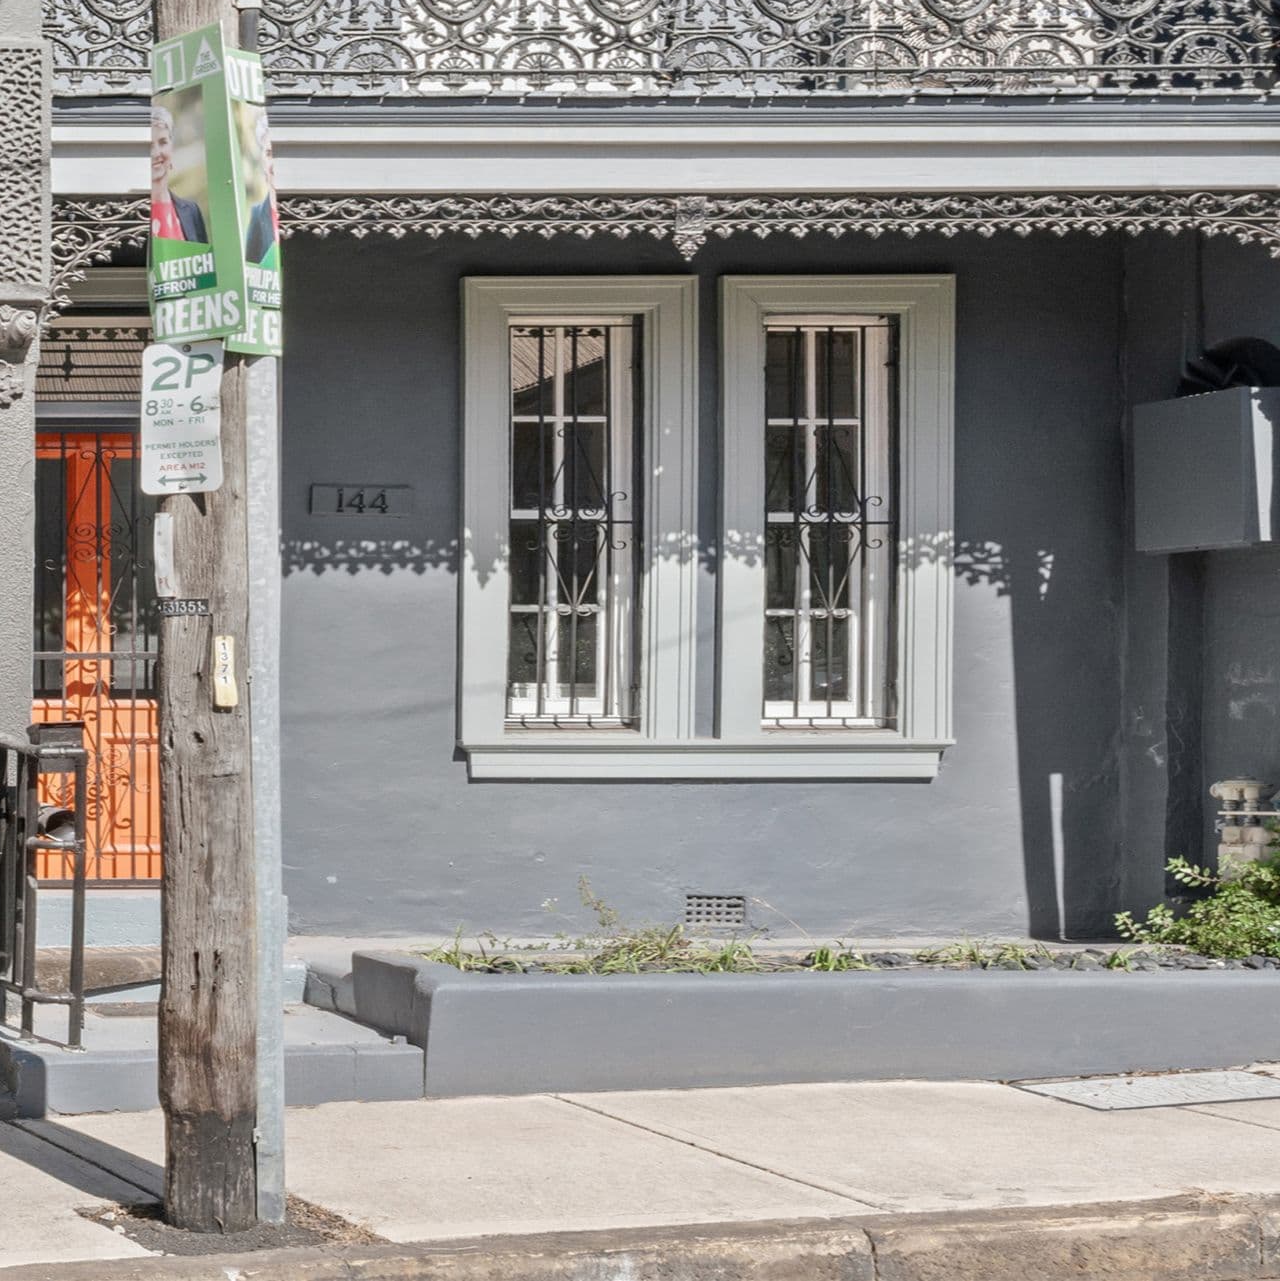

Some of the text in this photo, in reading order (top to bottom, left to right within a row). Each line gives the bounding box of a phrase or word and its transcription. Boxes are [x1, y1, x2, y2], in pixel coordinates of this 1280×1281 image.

[159, 252, 214, 282] VEITCH
[151, 353, 215, 391] 2P
[153, 418, 174, 427] MON
[188, 415, 205, 425] FRI
[145, 439, 217, 450] PERMIT HOLDERS
[160, 450, 204, 460] EXCEPTED
[159, 463, 187, 472] AREA
[336, 488, 389, 513] 144
[221, 642, 229, 684] 1371
